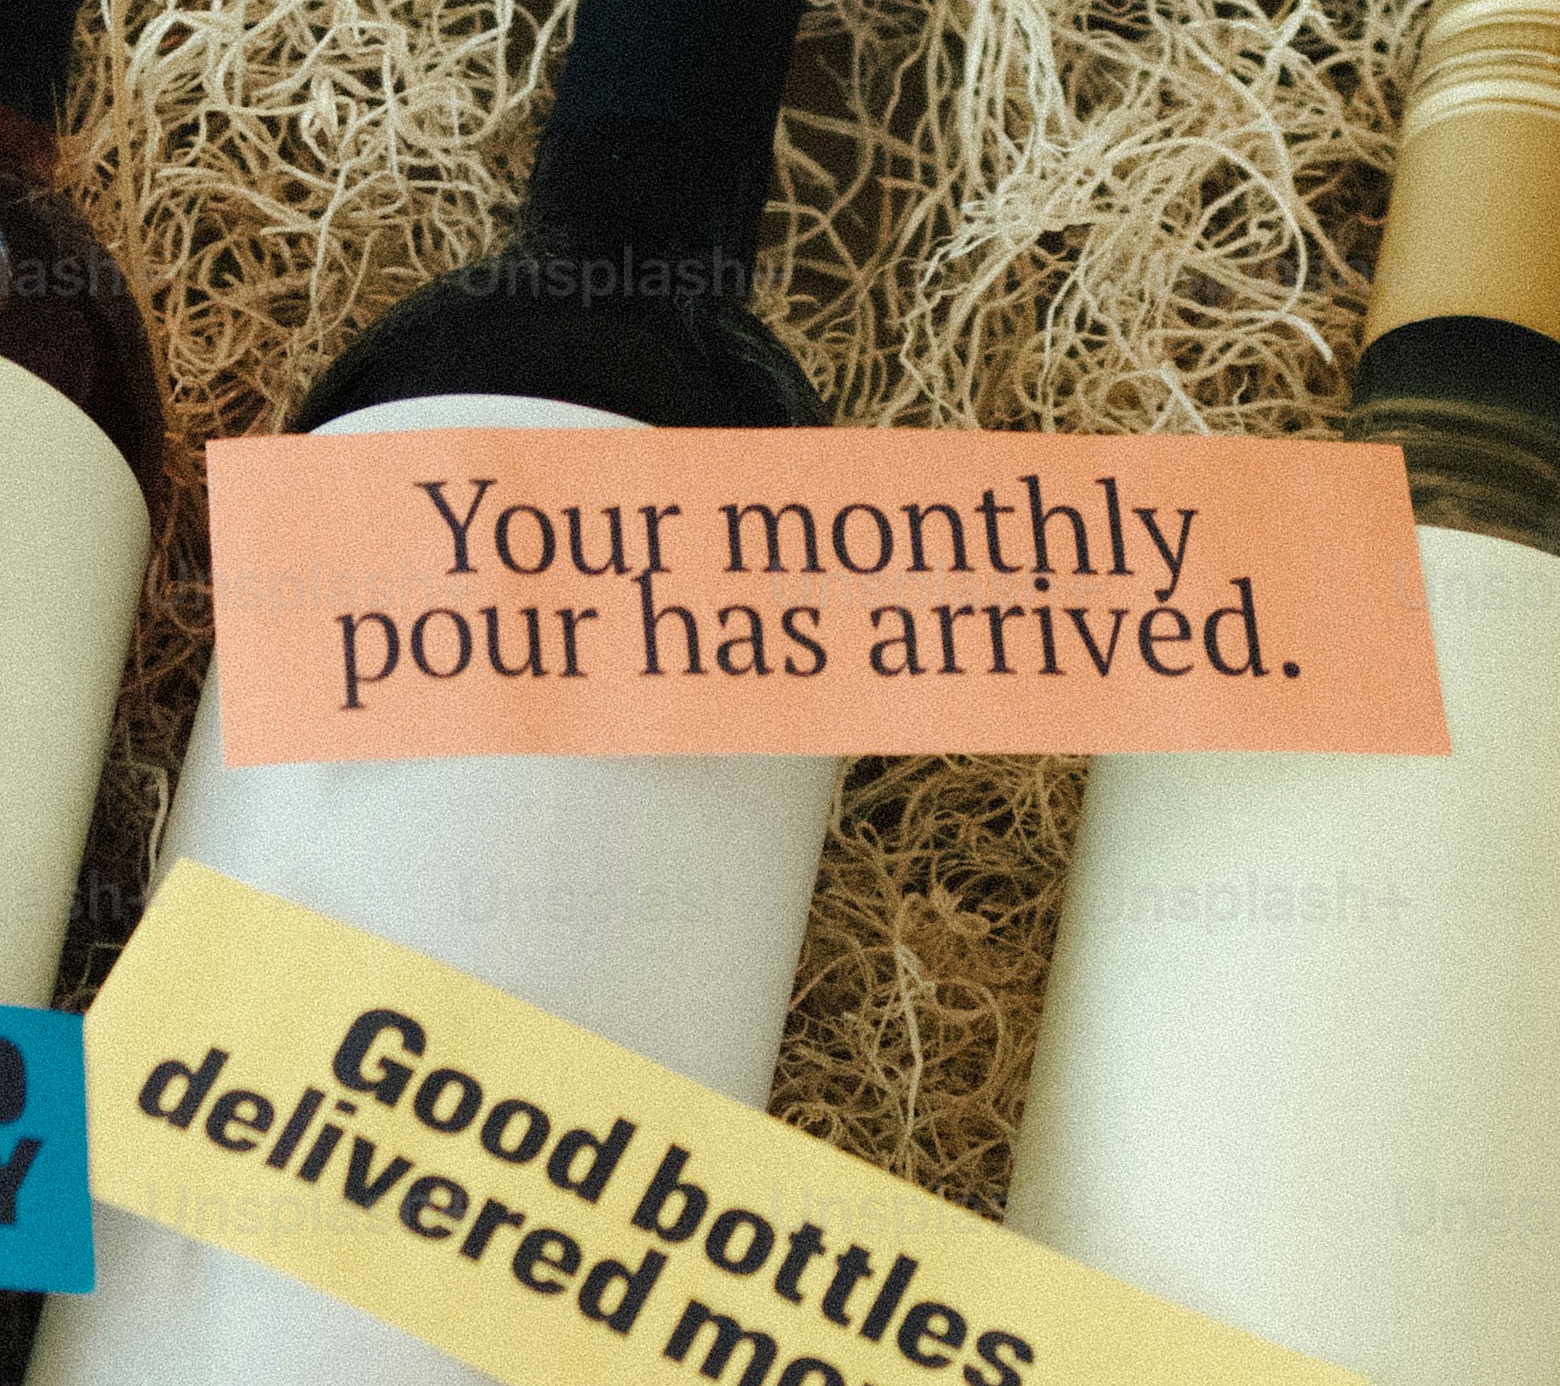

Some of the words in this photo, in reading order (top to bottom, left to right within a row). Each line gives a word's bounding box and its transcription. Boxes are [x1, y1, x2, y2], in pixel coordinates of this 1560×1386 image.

[415, 478, 680, 576] Your
[720, 474, 1199, 602] monthly
[335, 607, 595, 709] pour
[630, 569, 828, 677] has
[868, 576, 1301, 678] arrived.
[333, 1009, 635, 1203] Good
[138, 1049, 667, 1335] delivered
